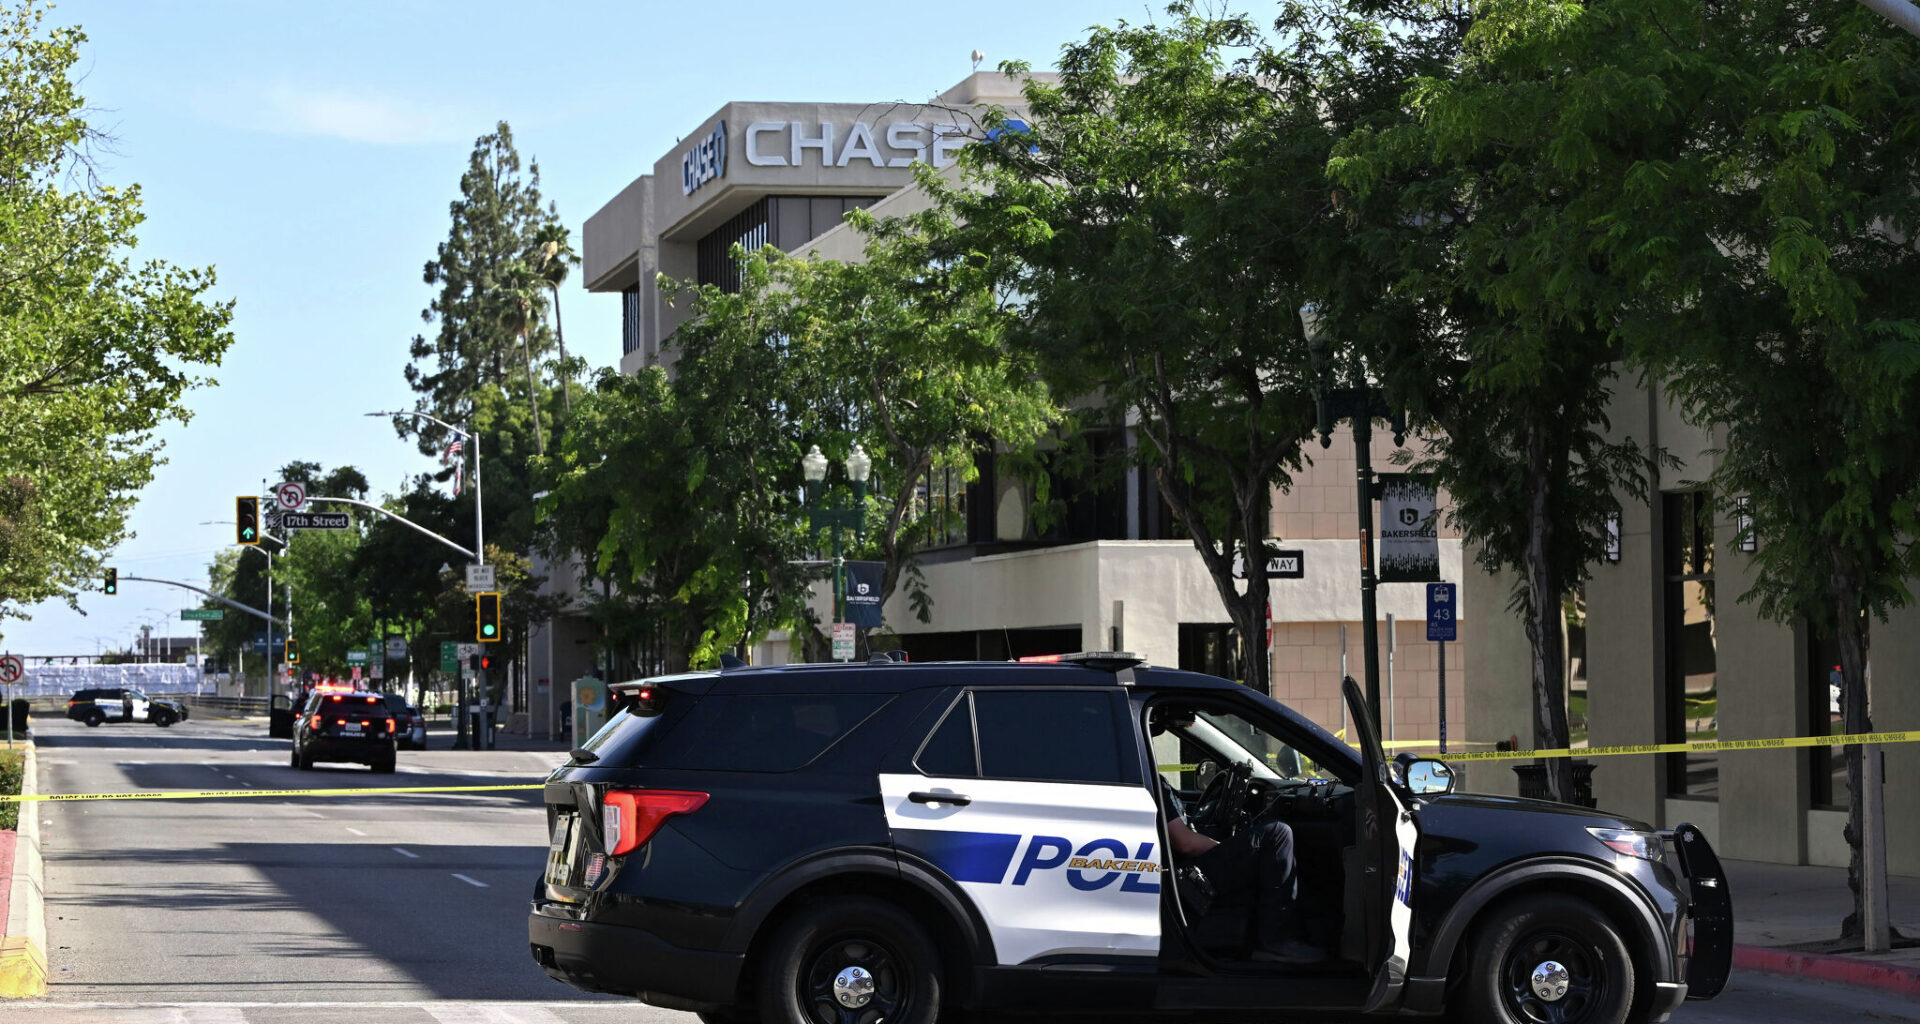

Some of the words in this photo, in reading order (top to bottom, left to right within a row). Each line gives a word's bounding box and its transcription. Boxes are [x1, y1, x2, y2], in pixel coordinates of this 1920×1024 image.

[745, 121, 972, 168] CHASE
[682, 133, 715, 196] CHASE
[287, 516, 308, 526] 17th
[312, 516, 346, 526] Street
[1382, 530, 1437, 538] BAKERSFIELD
[1271, 559, 1294, 570] WAY
[1434, 608, 1450, 620] 43
